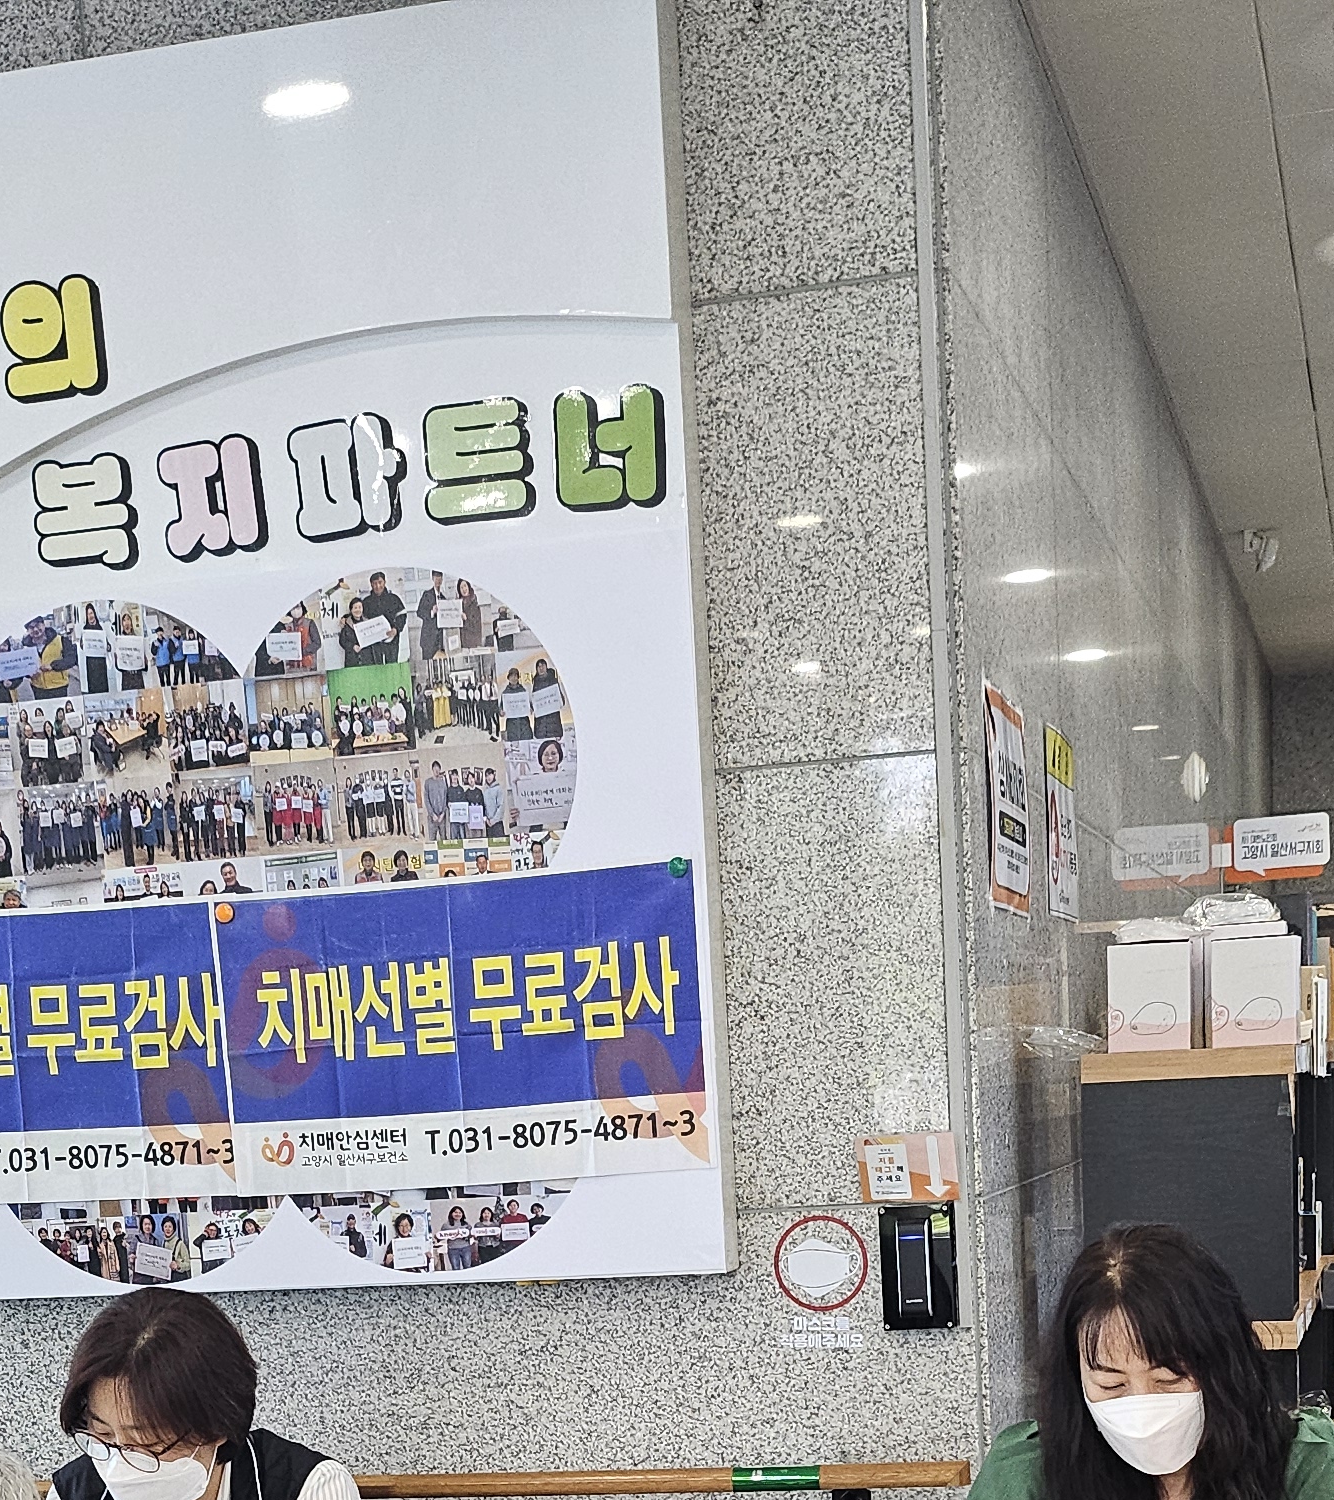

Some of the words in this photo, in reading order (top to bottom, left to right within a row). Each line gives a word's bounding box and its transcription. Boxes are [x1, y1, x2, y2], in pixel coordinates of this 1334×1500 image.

[1242, 845, 1268, 861] 고양시
[1270, 839, 1324, 858] 일산서구지회
[256, 957, 456, 1064] 치매선별
[469, 936, 680, 1051] 무료검사
[26, 973, 220, 1076] 무료검사
[298, 1127, 408, 1152] 치매안심센터
[424, 1109, 697, 1158] T.031-8075-4871~3
[301, 1154, 333, 1168] 고양시
[335, 1151, 409, 1167] 일산서구보건소
[876, 1174, 903, 1183] 주세요
[791, 1316, 850, 1332] 마스크를
